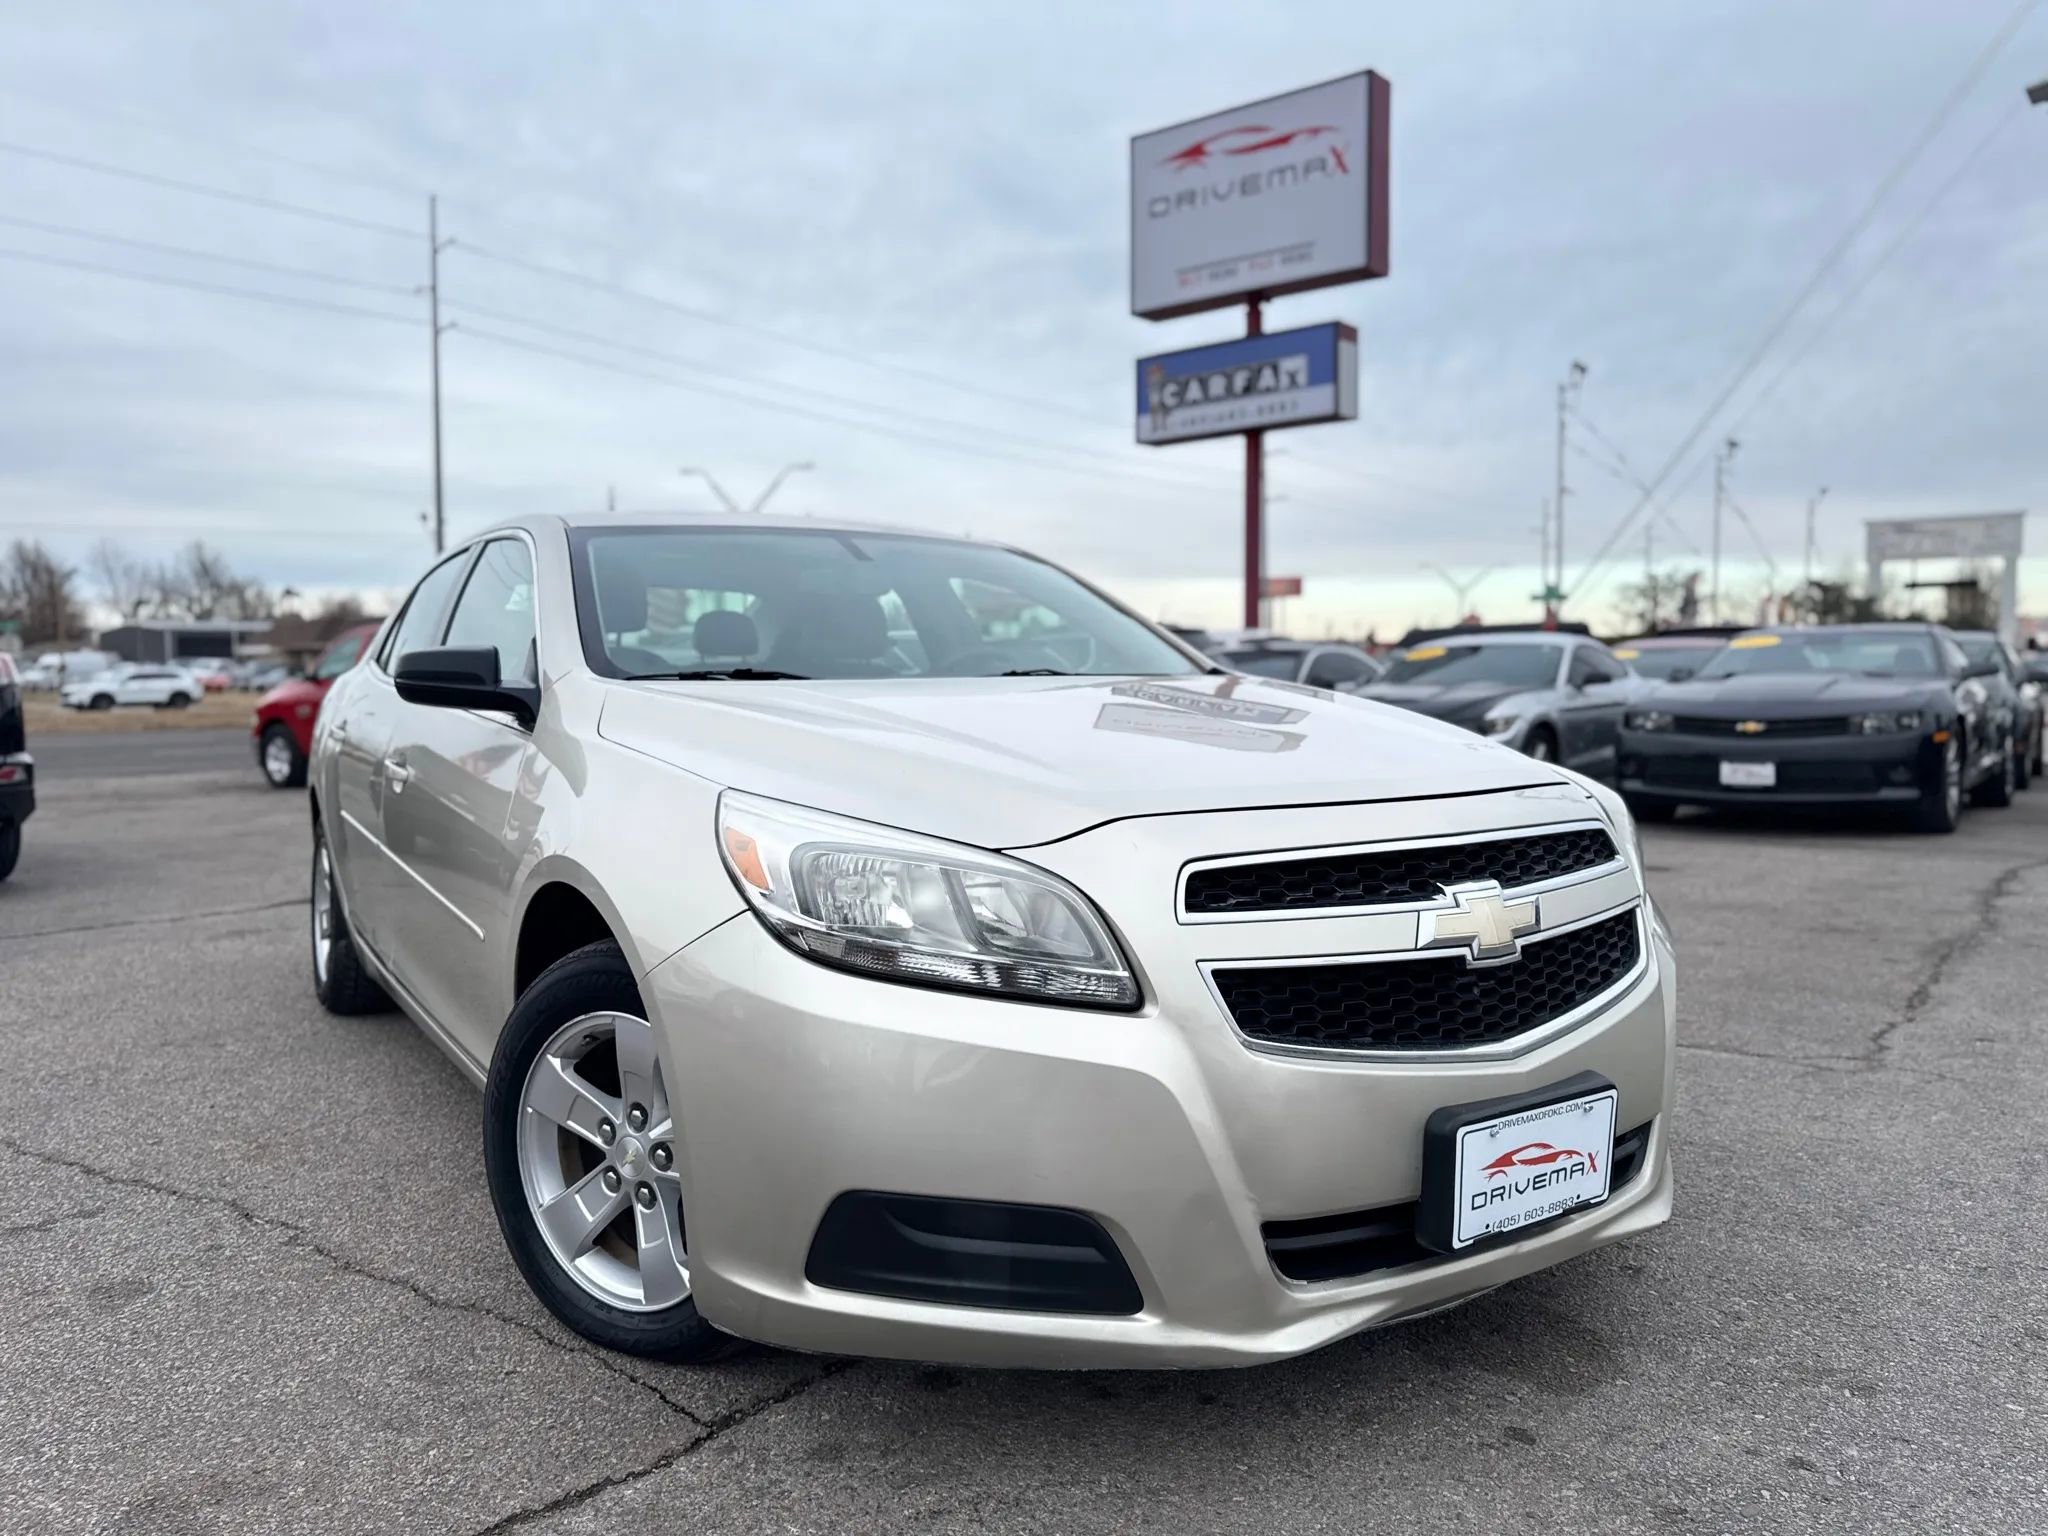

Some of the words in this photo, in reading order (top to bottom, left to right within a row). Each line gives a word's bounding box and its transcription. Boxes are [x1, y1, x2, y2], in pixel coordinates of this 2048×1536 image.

[1148, 144, 1350, 219] DRIVEMAX
[1498, 1101, 1584, 1131] DRIVEMAXOFOKC.COM
[1471, 1150, 1599, 1211] DRIVEMAX
[1492, 1213, 1520, 1232] (405)
[1524, 1196, 1575, 1221] 603-8883
